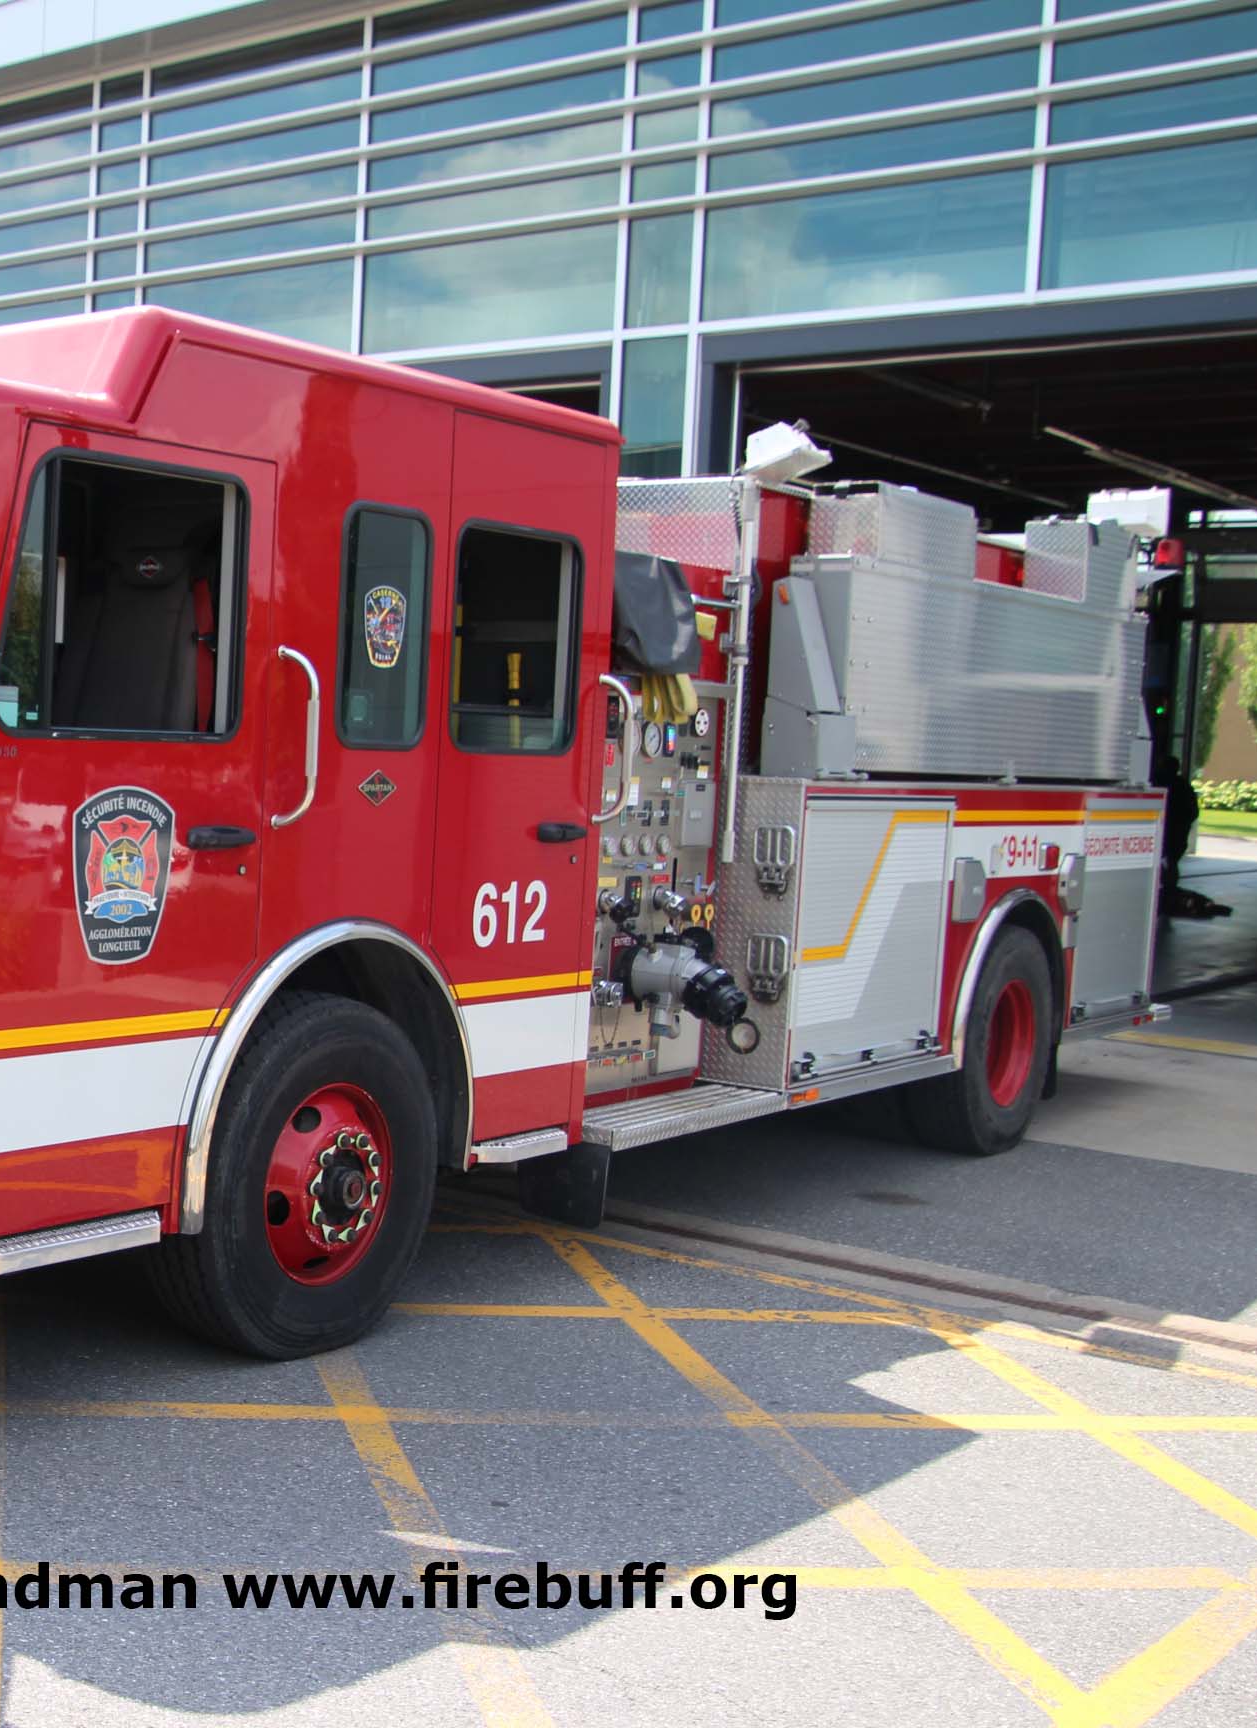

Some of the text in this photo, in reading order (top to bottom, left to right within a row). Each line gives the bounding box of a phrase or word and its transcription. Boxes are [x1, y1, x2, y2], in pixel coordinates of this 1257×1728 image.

[81, 794, 168, 829] SÉCURITÉ INCENDIE
[1123, 836, 1154, 855] INCENDIE
[110, 904, 133, 916] 2002
[473, 880, 547, 948] 612
[88, 925, 152, 941] AGGLOMÉRATION
[98, 940, 142, 953] LONGUEUIL
